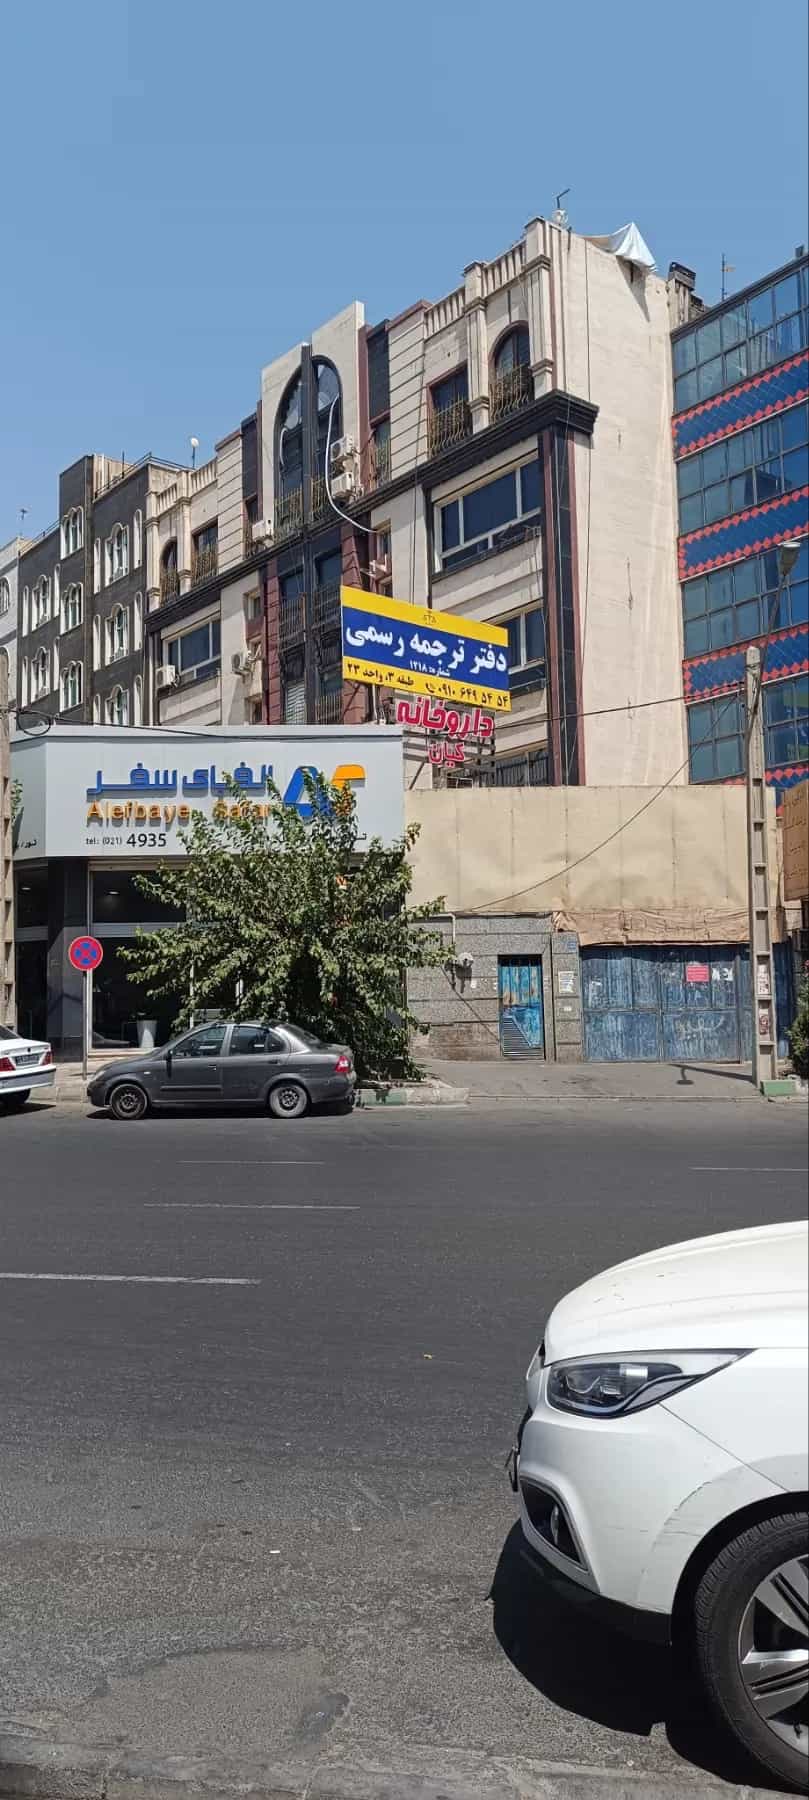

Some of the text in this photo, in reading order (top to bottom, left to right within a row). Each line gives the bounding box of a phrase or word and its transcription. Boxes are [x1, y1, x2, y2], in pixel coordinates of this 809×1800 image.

[345, 625, 507, 674] دفتر ترجمه رسمی
[362, 669, 383, 682] واحد
[396, 696, 495, 738] داروخانه
[428, 742, 466, 767] کیان
[86, 762, 178, 797] سفر
[86, 800, 191, 824] Alefbaye
[126, 832, 167, 848] 4935
